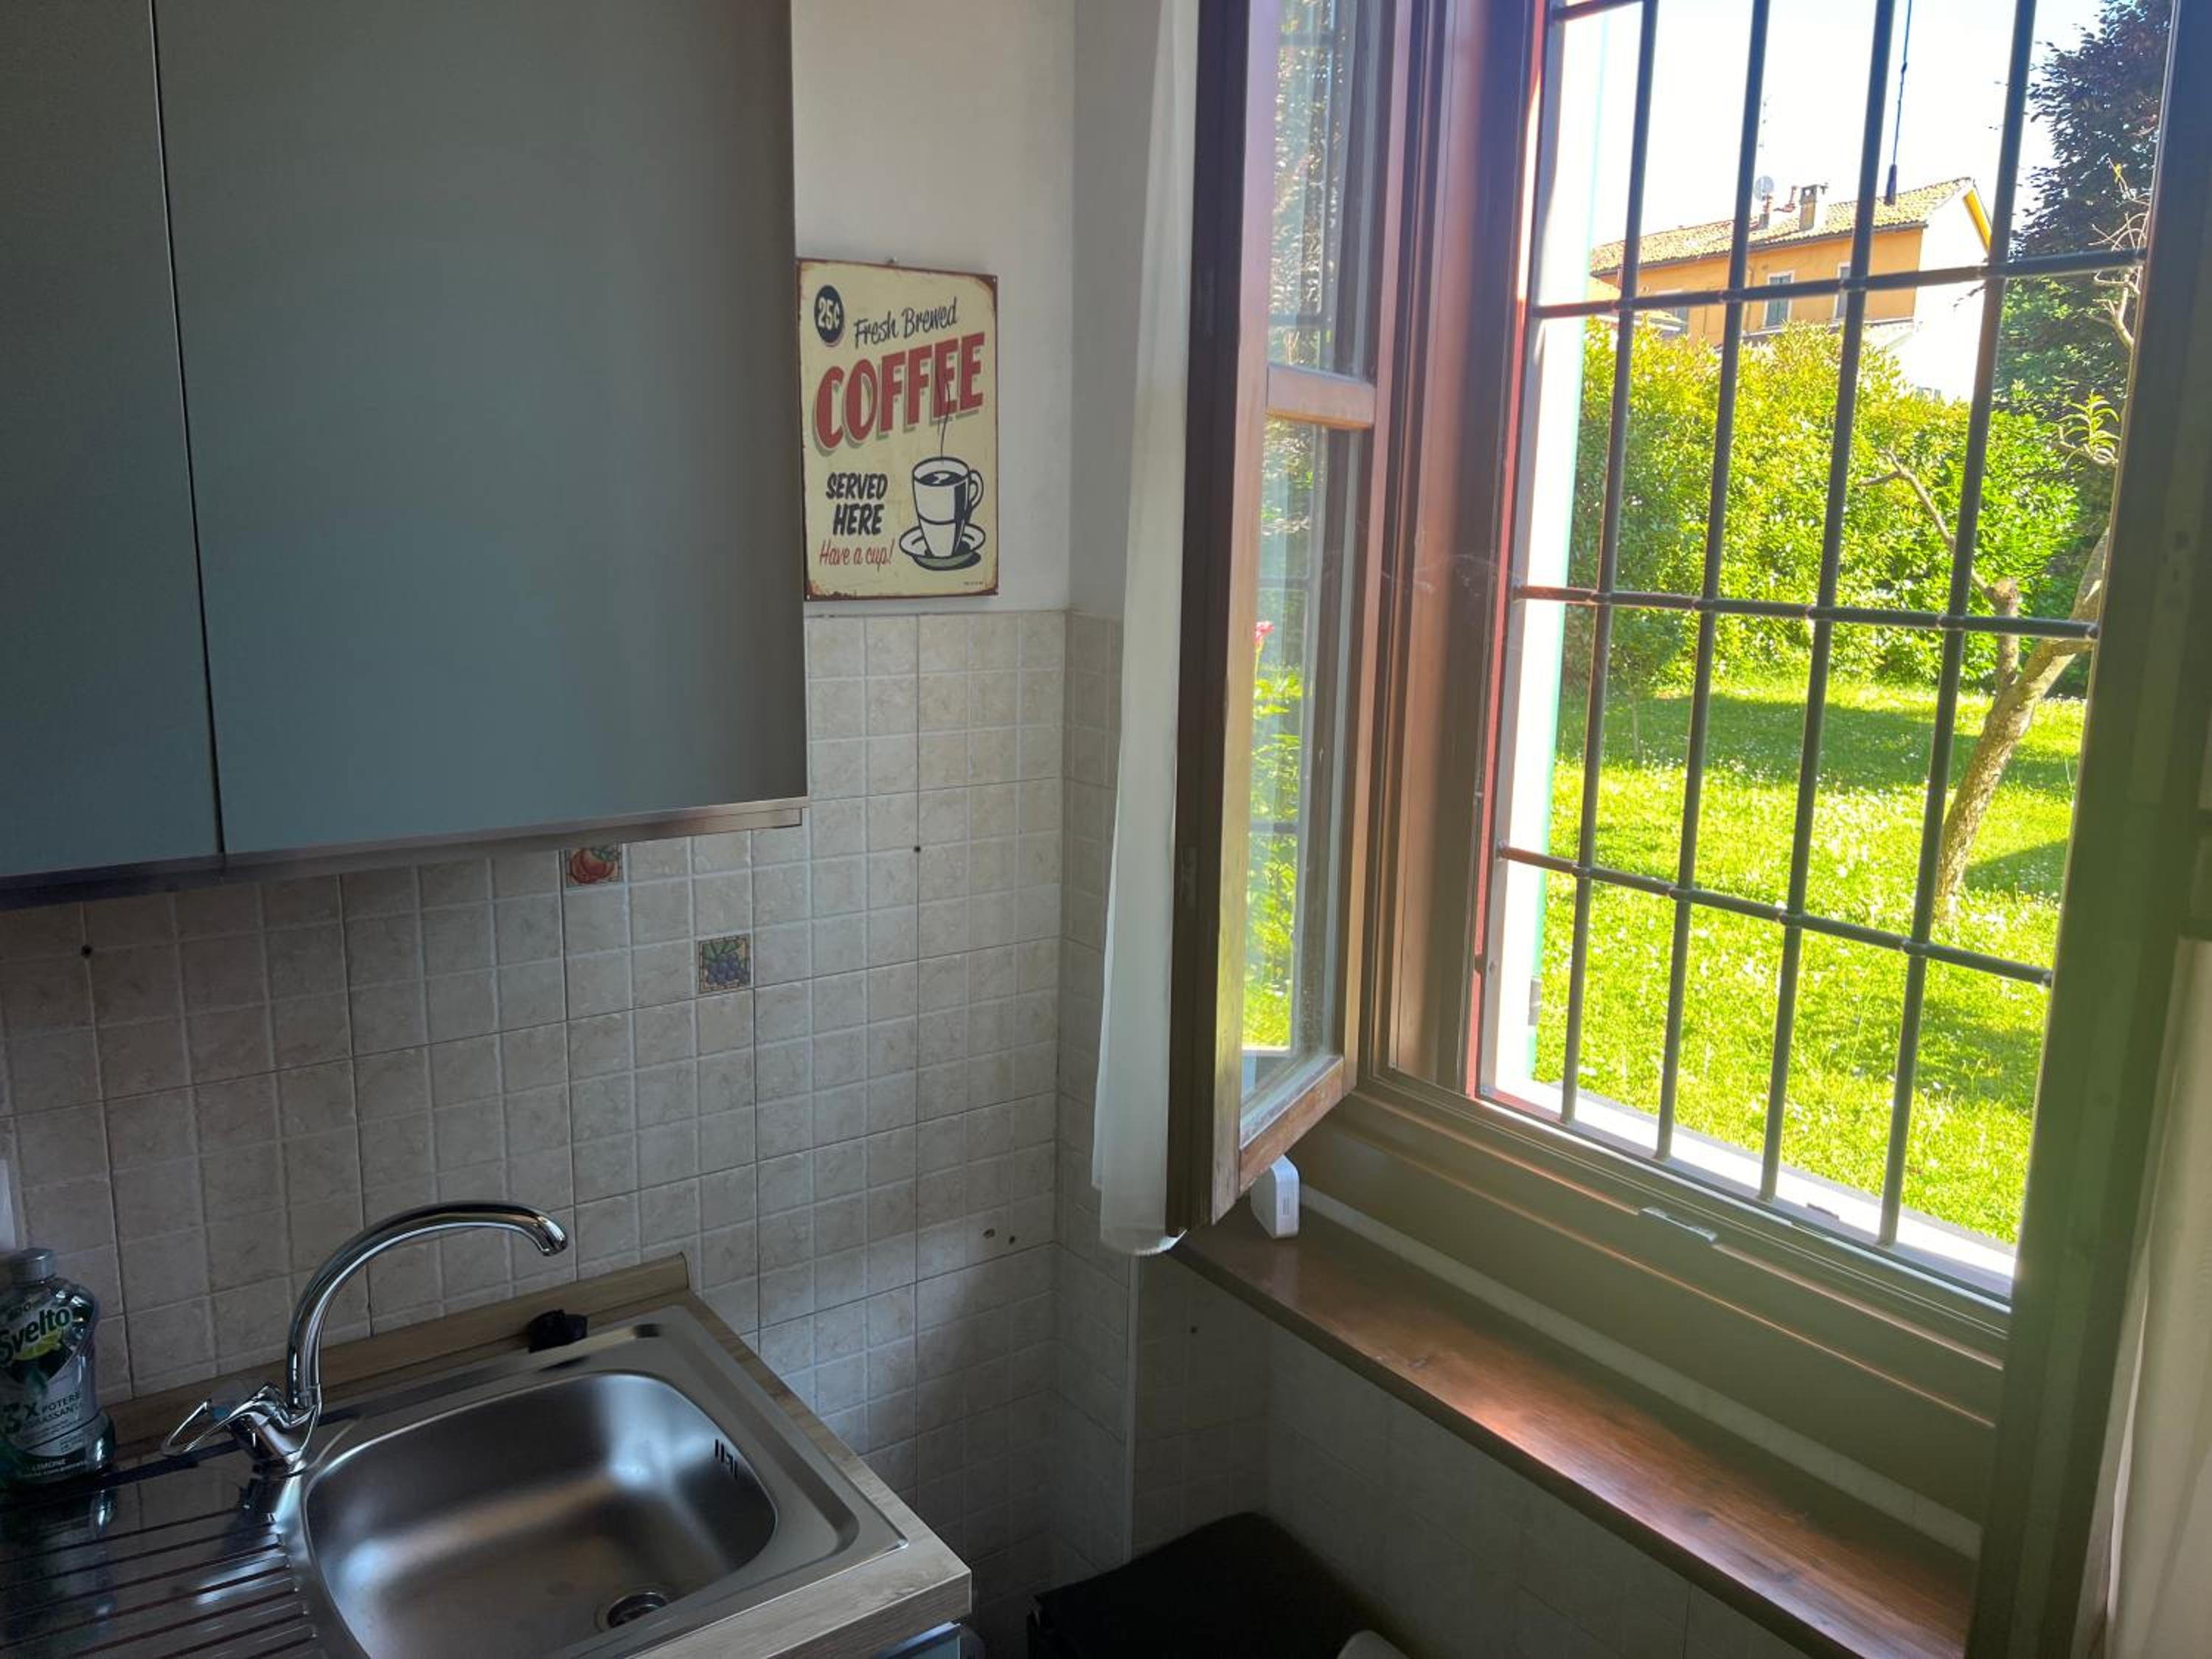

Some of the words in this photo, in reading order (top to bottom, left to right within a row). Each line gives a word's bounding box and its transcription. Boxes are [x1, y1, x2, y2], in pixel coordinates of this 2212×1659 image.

[854, 312, 898, 349] Fresh
[901, 296, 957, 339] Brewed
[815, 332, 985, 451] COFFEE
[825, 472, 888, 501] SERVED
[832, 504, 884, 536] HERE
[819, 540, 851, 566] Have
[852, 546, 863, 565] a
[0, 1308, 72, 1364] Svelto
